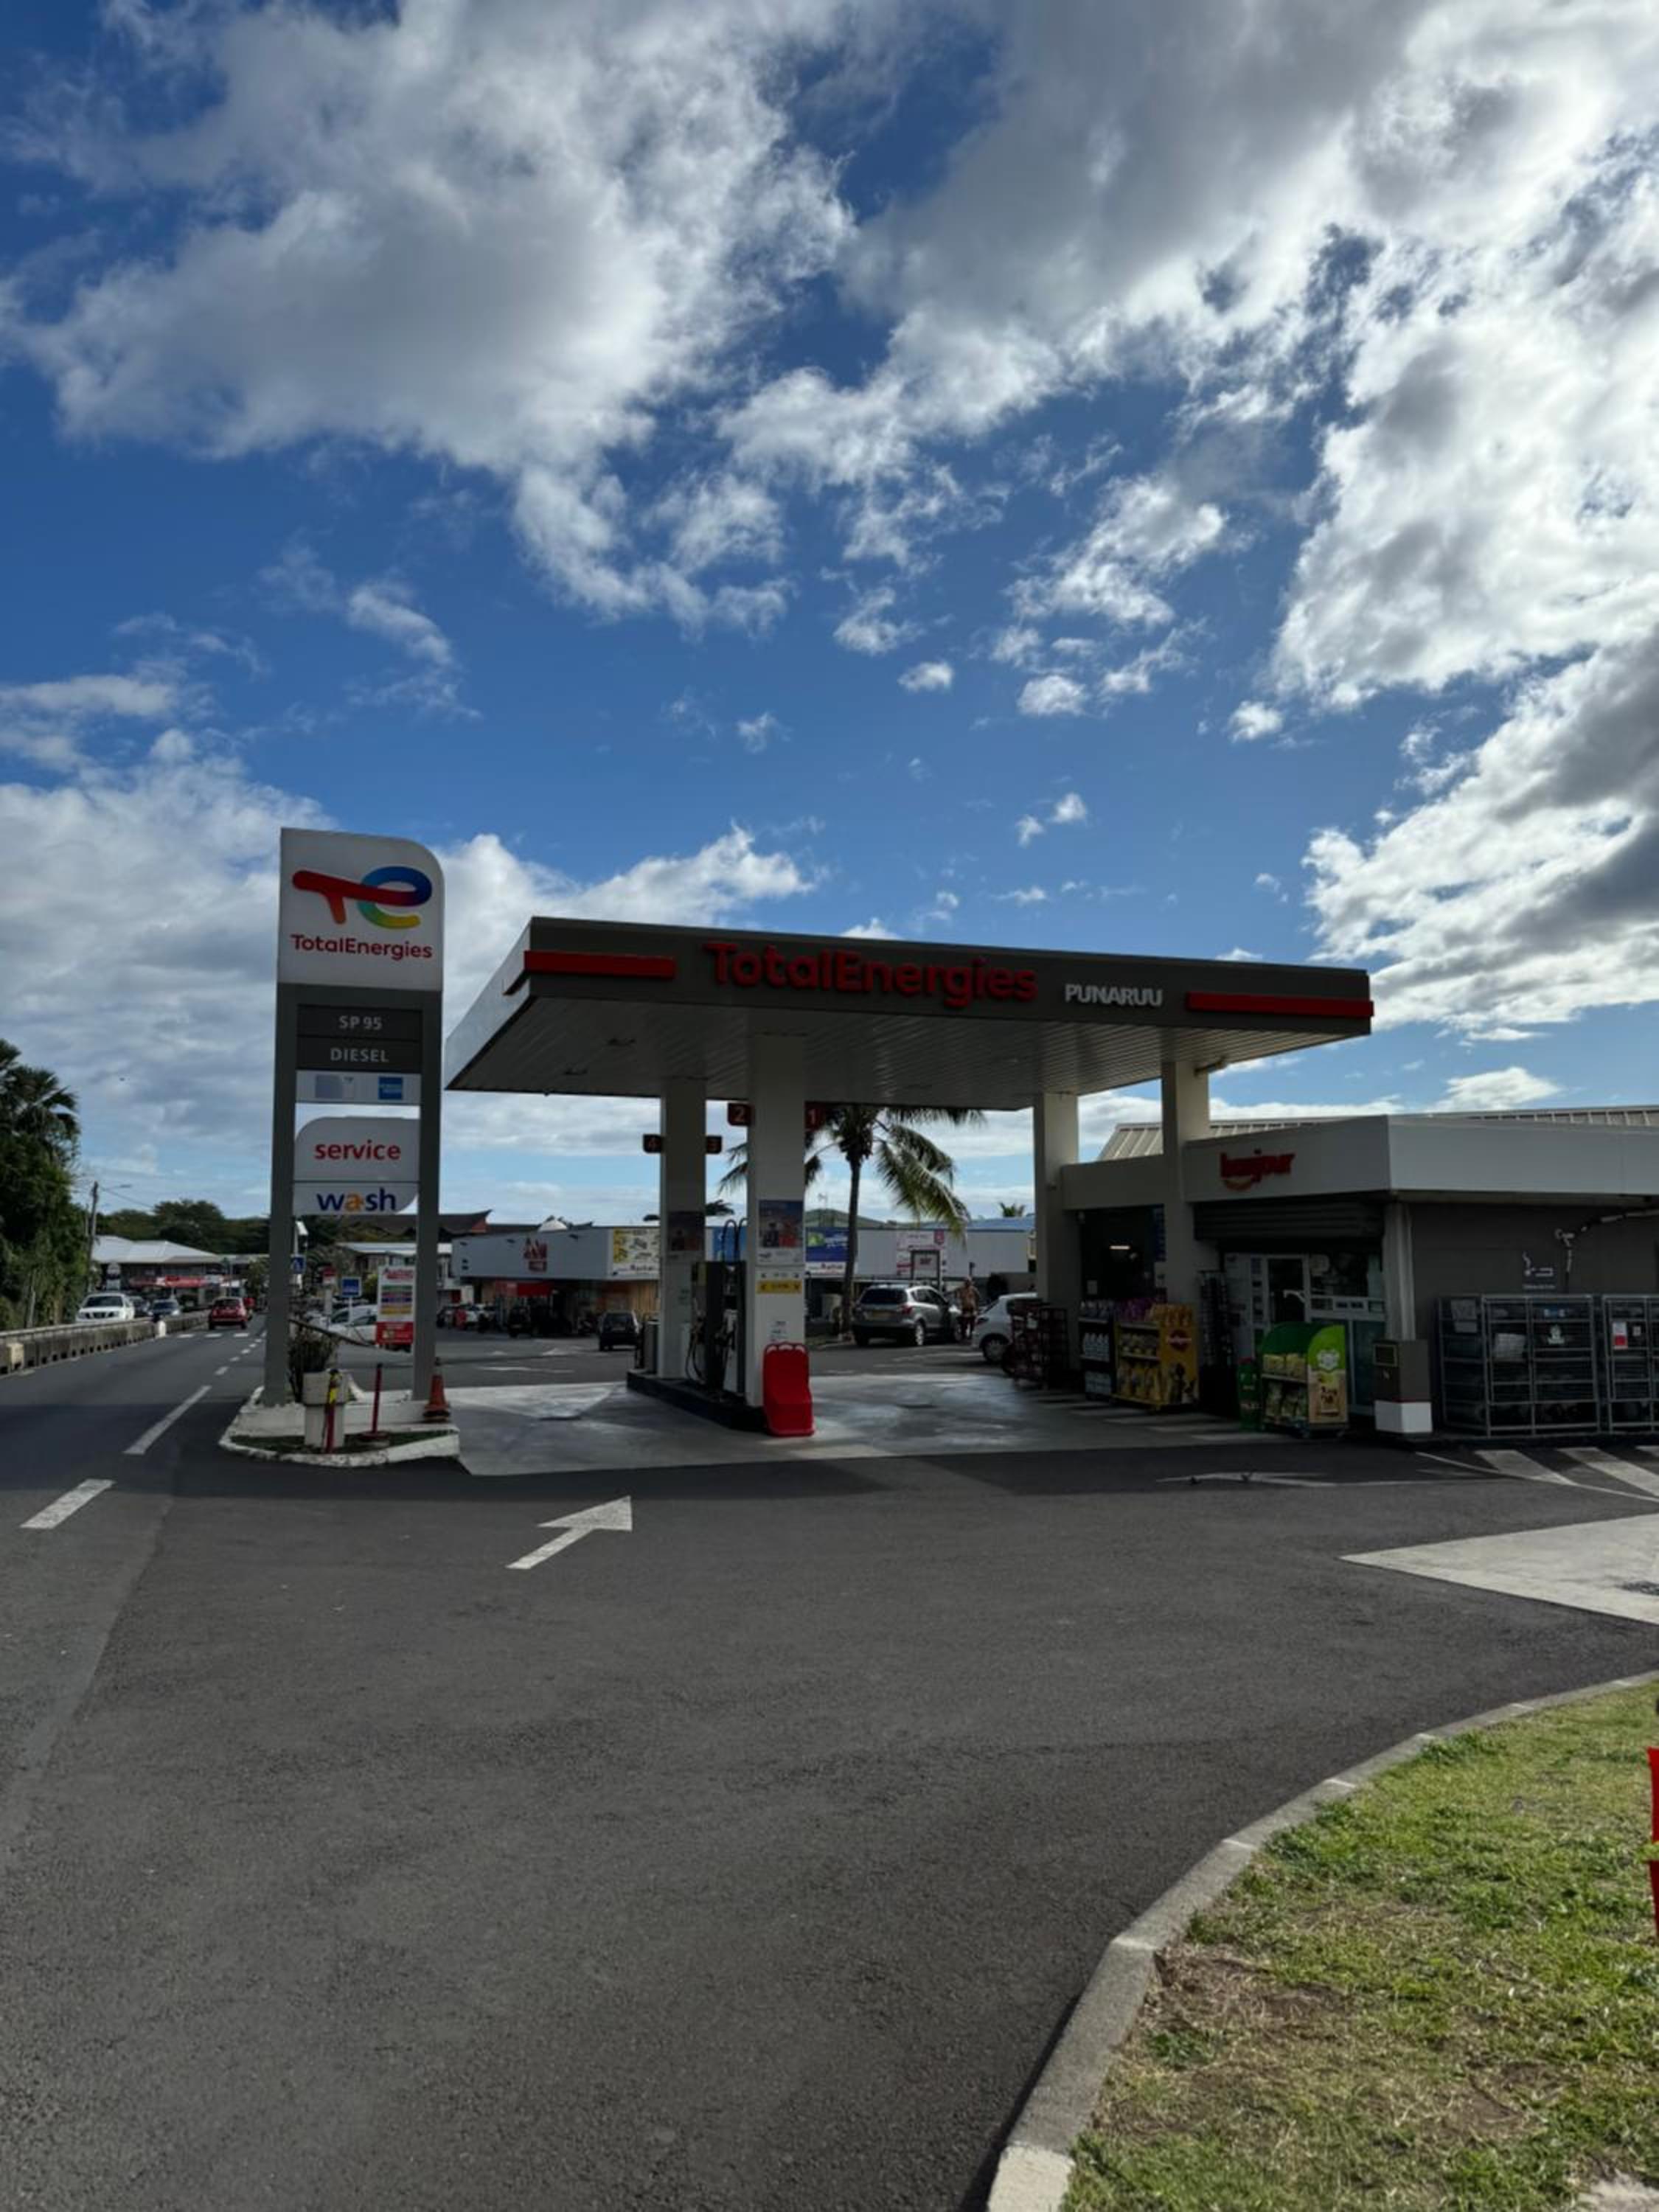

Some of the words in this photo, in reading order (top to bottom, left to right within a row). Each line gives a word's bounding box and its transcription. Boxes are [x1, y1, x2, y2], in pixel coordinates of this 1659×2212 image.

[291, 934, 433, 961] TotalEnergies
[705, 942, 1037, 1009] TotalEnergies
[1064, 983, 1164, 1007] PUNARUU
[330, 1048, 389, 1062] DIESEL
[734, 1106, 745, 1121] 2
[314, 1138, 401, 1160] service
[316, 1187, 396, 1211] wash
